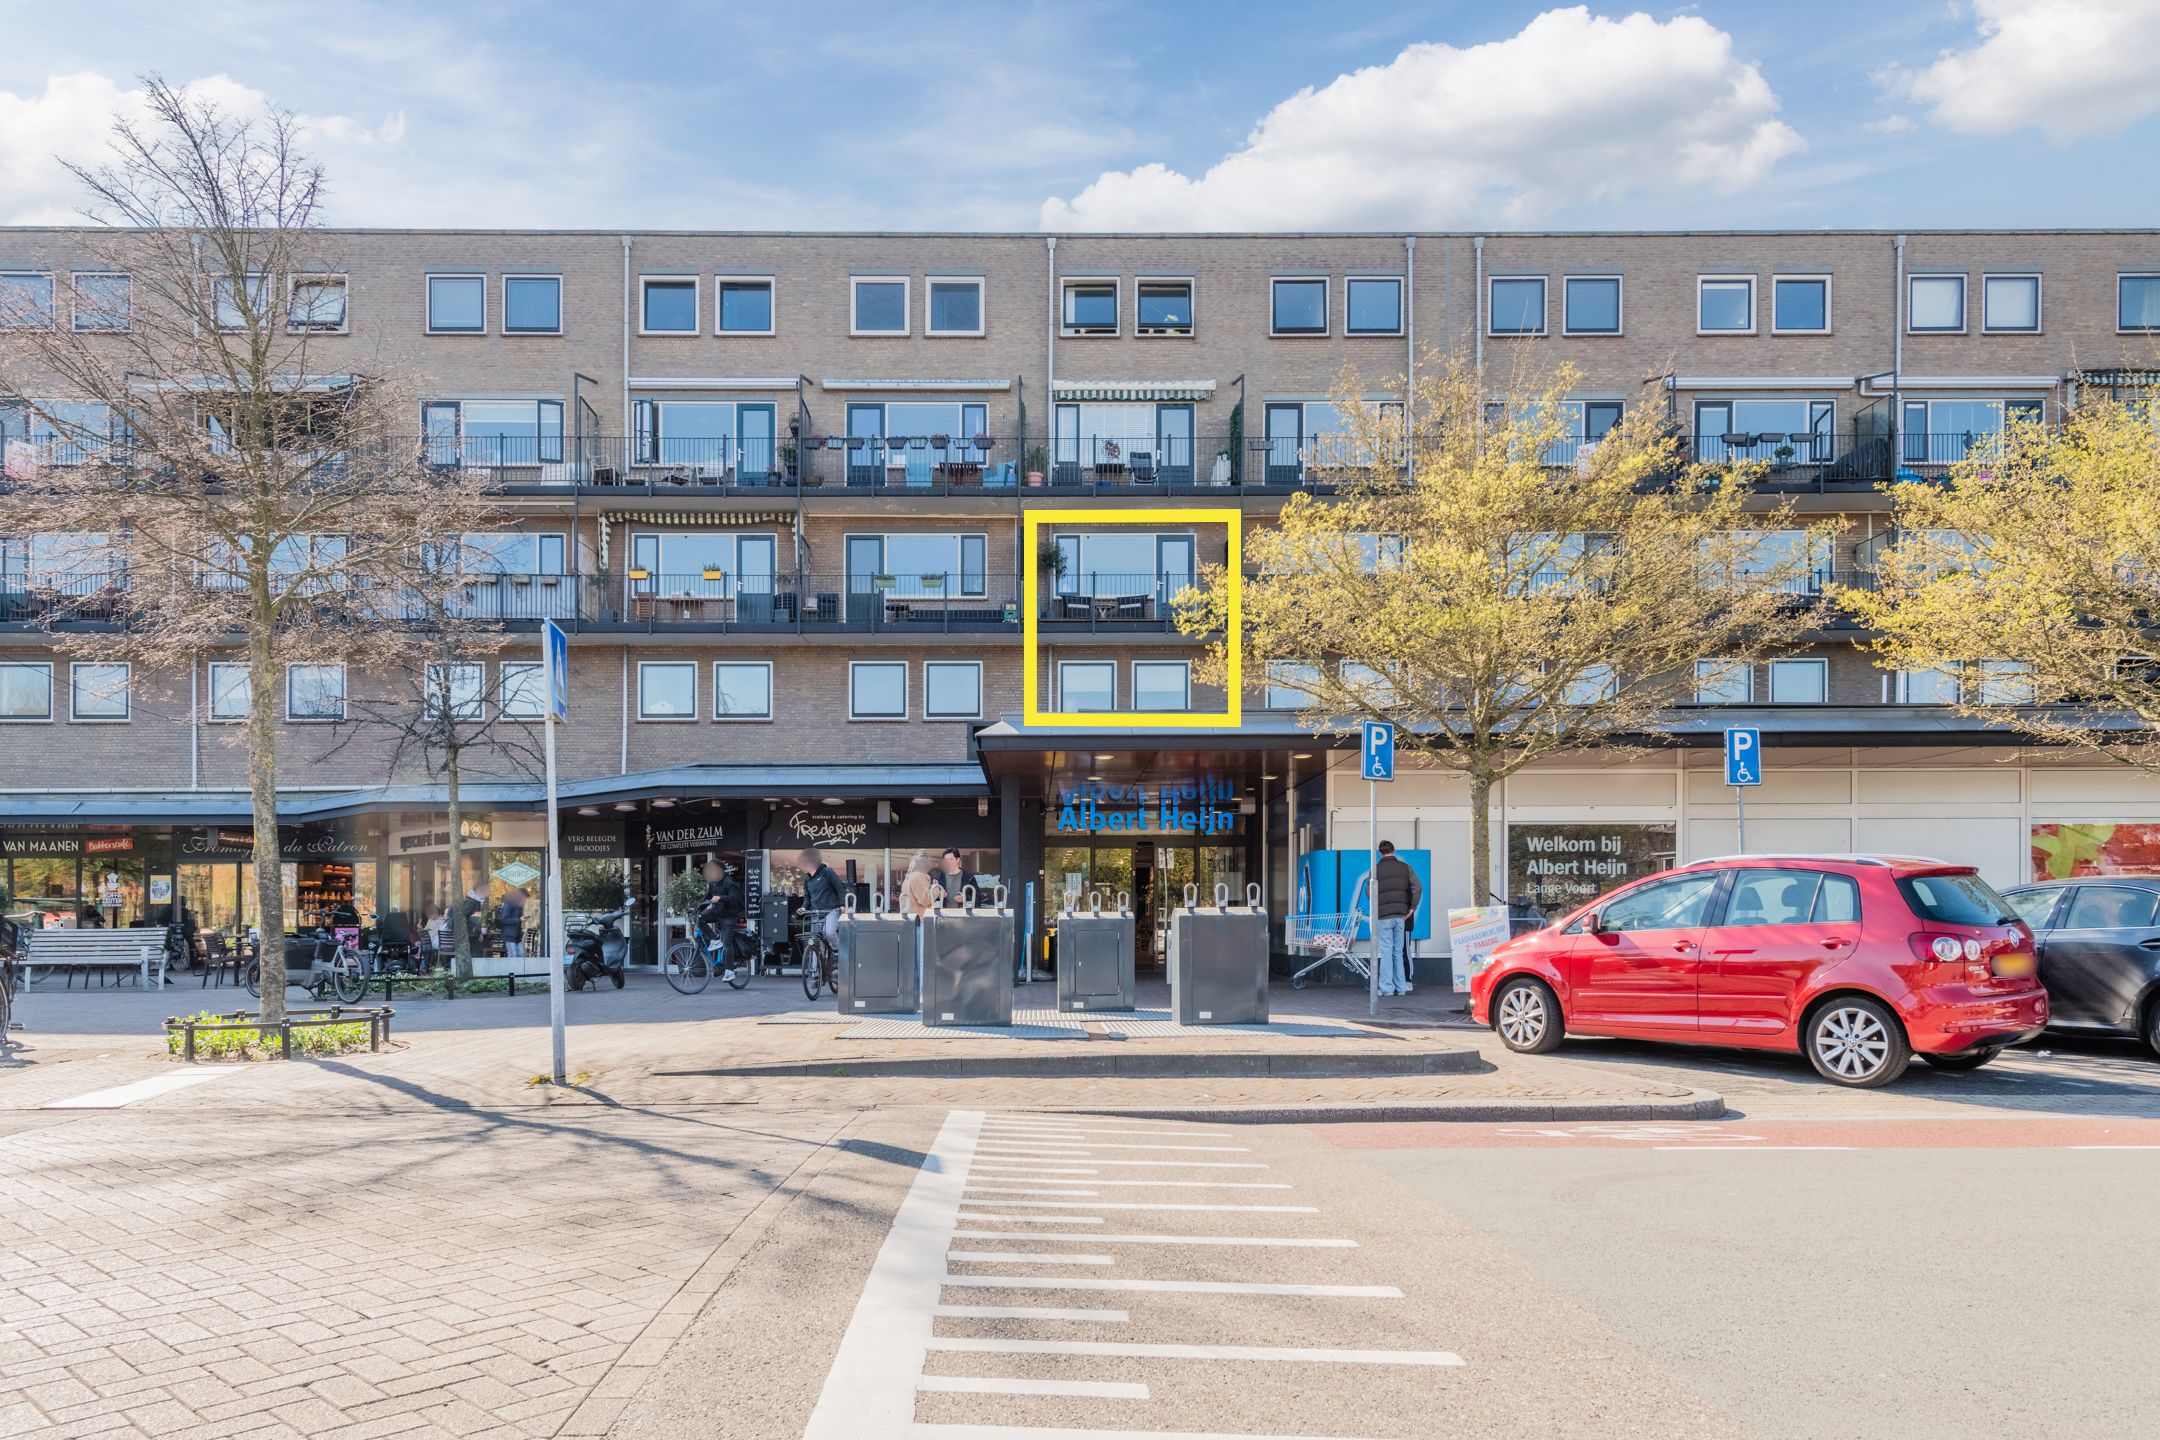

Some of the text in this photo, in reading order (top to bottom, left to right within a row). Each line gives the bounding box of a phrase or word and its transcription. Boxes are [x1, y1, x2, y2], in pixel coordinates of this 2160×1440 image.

[1371, 726, 1388, 755] P
[1734, 732, 1752, 760] P
[1057, 804, 1234, 836] Albert Heijn
[568, 835, 617, 843] VERS BELEGDE
[656, 825, 723, 842] VAN DER ZALM
[3, 841, 79, 852] VAN MAANEN
[283, 838, 303, 853] du
[307, 835, 370, 853] Patron
[1527, 836, 1621, 856] Welkom bij
[1526, 859, 1627, 878] Albert Heijn
[1527, 882, 1597, 896] Lange Voort
